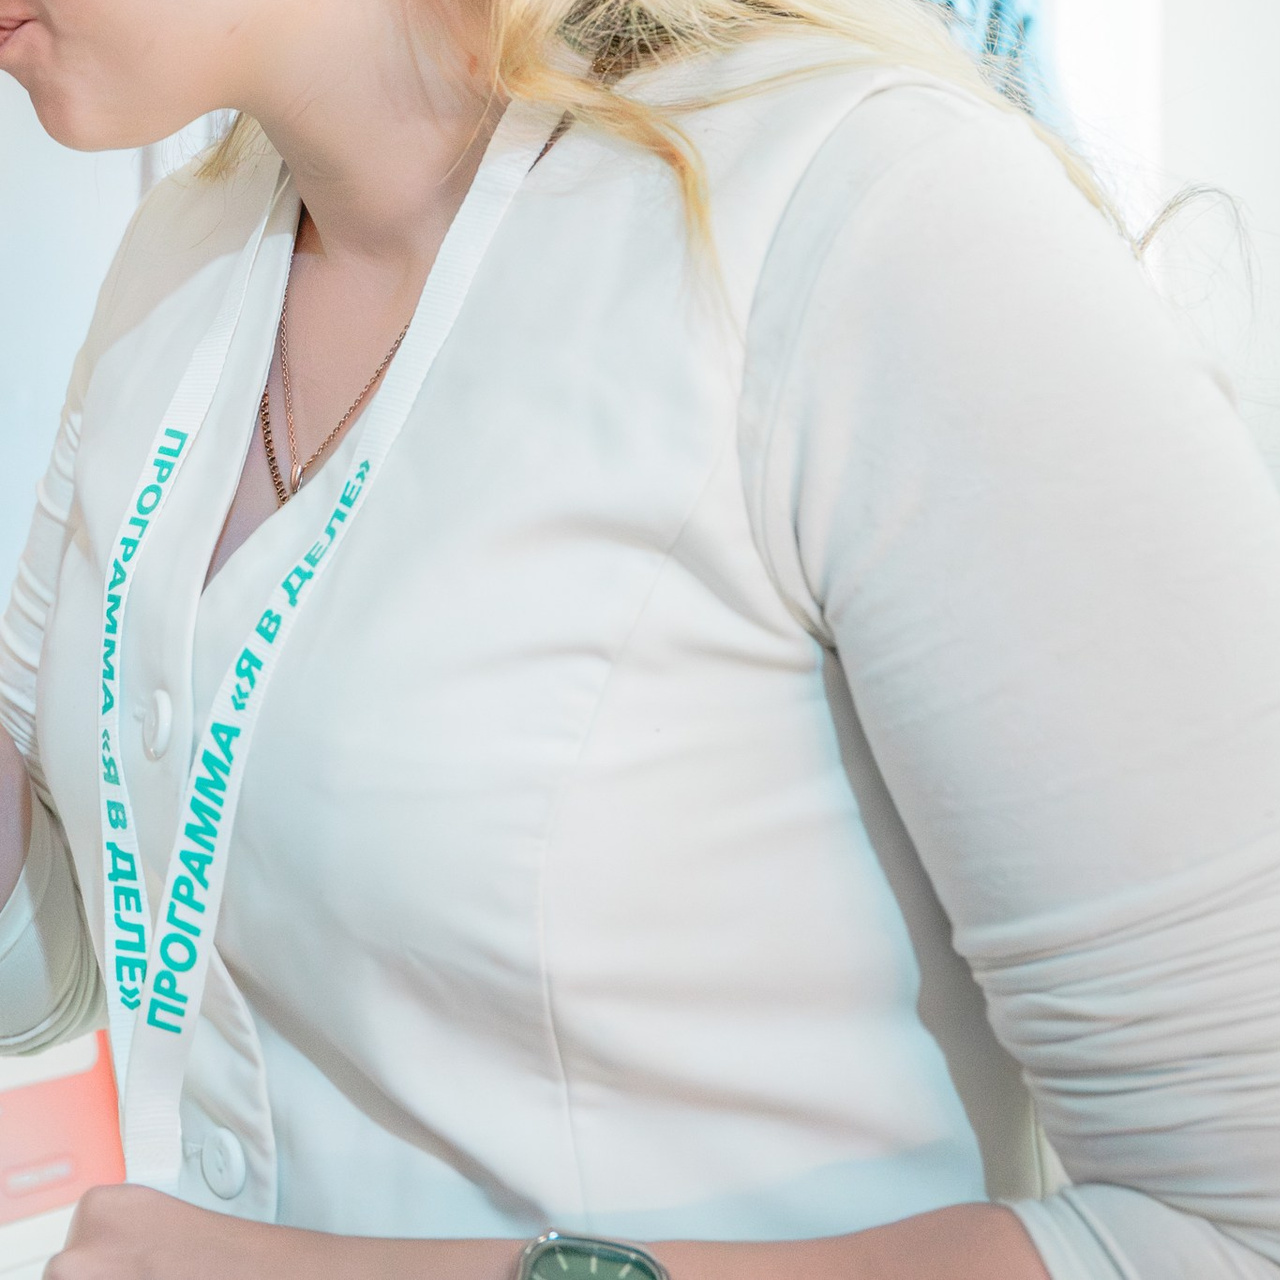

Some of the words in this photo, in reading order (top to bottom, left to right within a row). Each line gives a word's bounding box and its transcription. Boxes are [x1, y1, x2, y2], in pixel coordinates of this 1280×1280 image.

[100, 427, 189, 717] ПРОГРАММА
[100, 727, 121, 786] «Я
[105, 798, 128, 831] В
[146, 720, 242, 1036] ПРОГРАММА
[229, 646, 265, 712] «Я
[254, 608, 284, 646] В
[281, 460, 372, 608] ДЕЛЕ»
[105, 840, 148, 1012] ДЕЛЕ»
